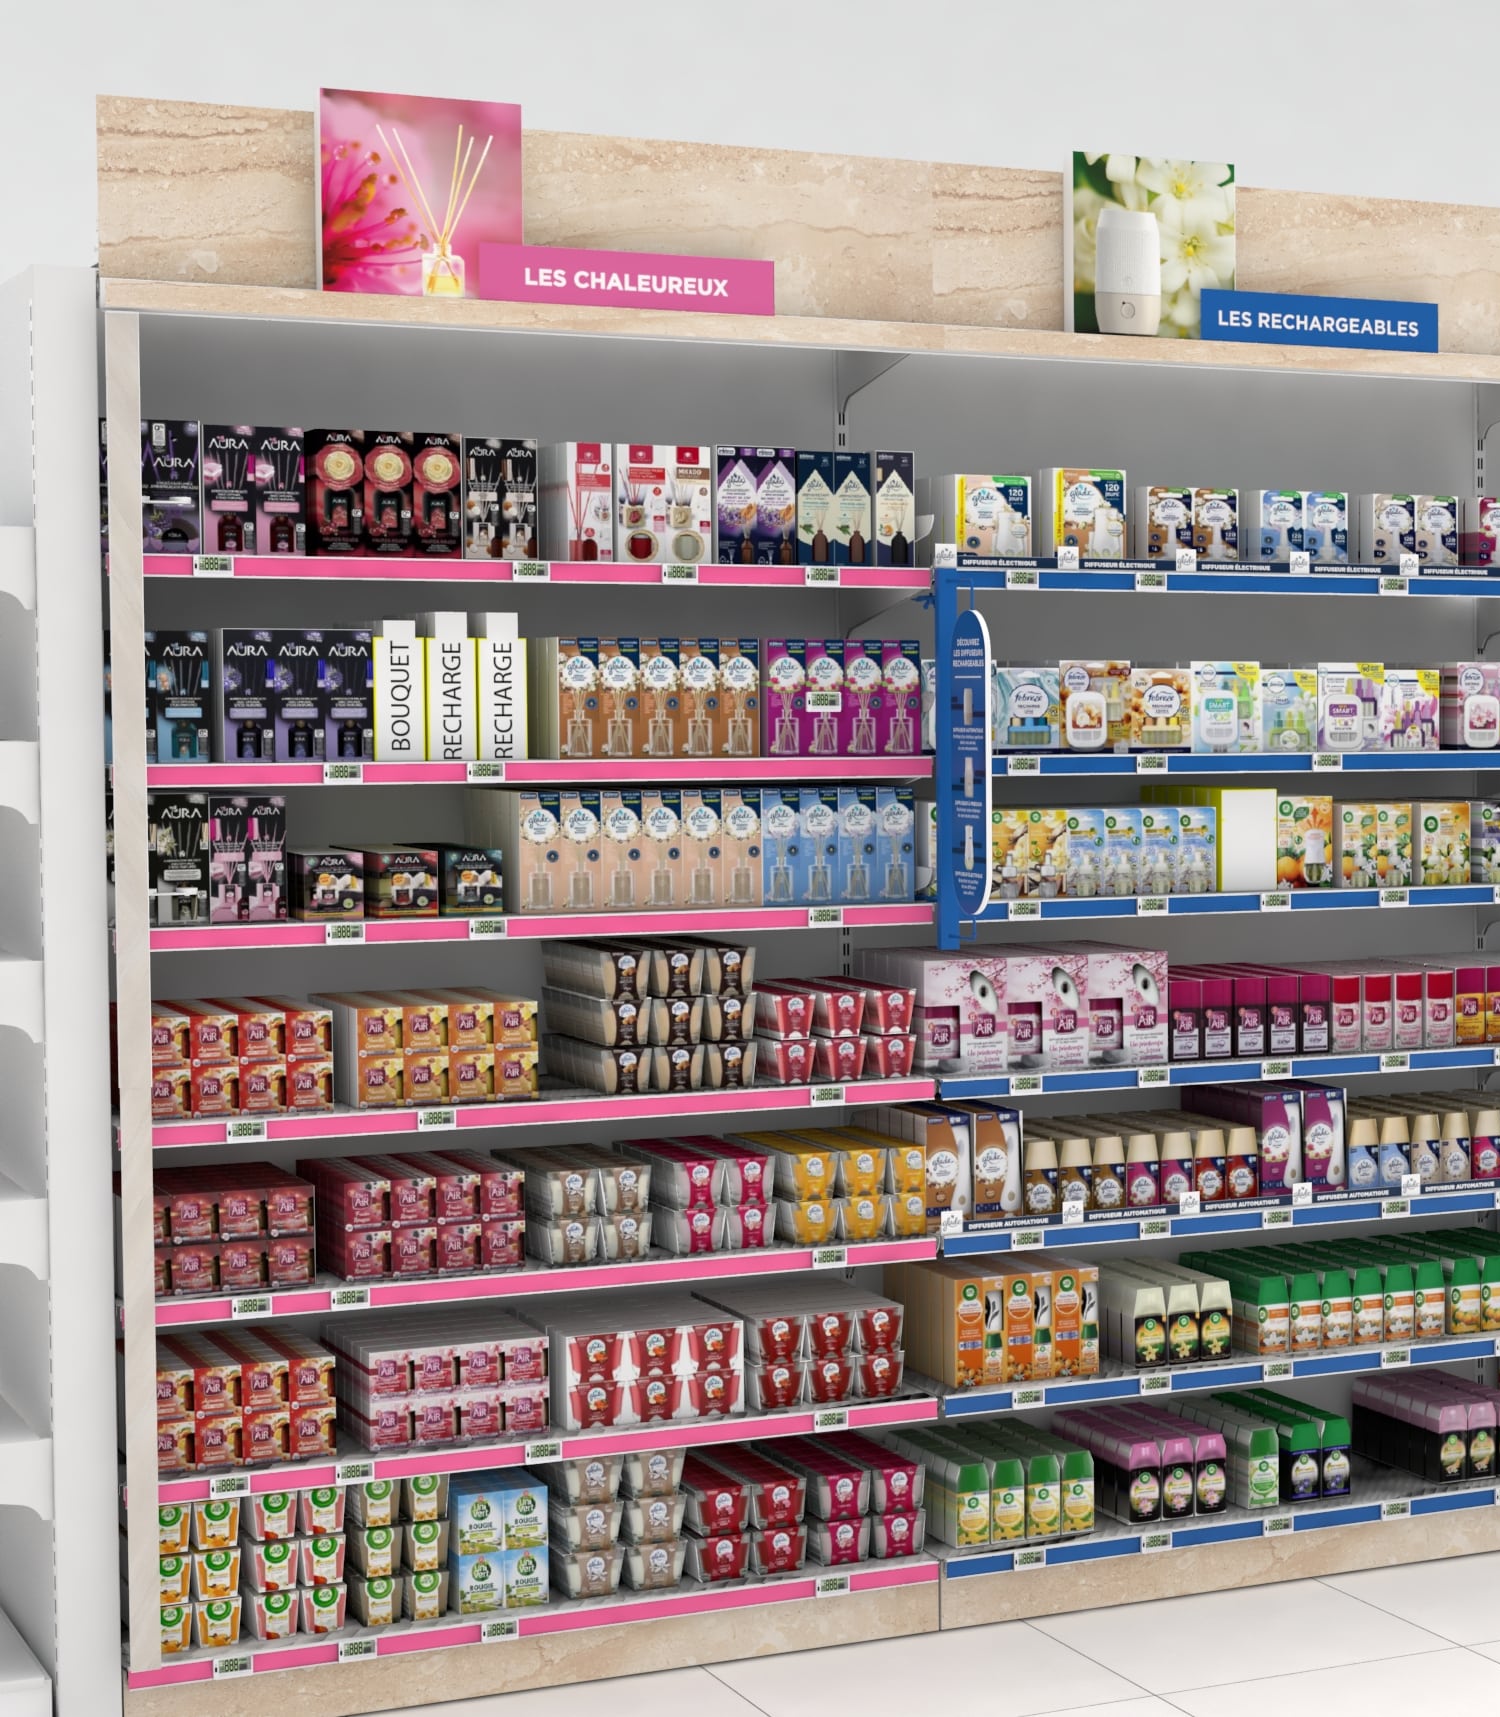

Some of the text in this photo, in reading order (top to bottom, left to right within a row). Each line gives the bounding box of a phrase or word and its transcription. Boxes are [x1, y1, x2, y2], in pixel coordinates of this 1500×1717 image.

[525, 267, 729, 297] LES CHALEUREUX
[1218, 310, 1418, 337] LES RECHARGEABLES
[1105, 484, 1120, 492] 120
[1009, 489, 1023, 497] 120
[963, 558, 1037, 567] DIFFUSEUR ÉLECTRIQUE
[1084, 561, 1156, 569] DIFFUSEUR ÉLECTRIQUE
[1201, 563, 1234, 571] DIFFUSEUR
[1424, 568, 1453, 576] DIFFUSEUR
[390, 640, 411, 751] BOUQUET
[442, 642, 462, 760] RECHARGE
[494, 642, 513, 760] RECHARGE
[1456, 1181, 1495, 1189] AUTOMATIQUE
[1350, 1190, 1389, 1198] AUTOMATIQUE
[1205, 1198, 1280, 1210] DIFFUSEUR AUTOMATIQUE
[1089, 1208, 1166, 1220] DIFFUSEUR AUTOMATIQUE
[969, 1217, 1048, 1230] DIFFUSEUR AUTOMATIQUE
[515, 1516, 538, 1524] BOUGIE
[515, 1577, 539, 1585] BOUGIE
[470, 1583, 493, 1591] BOUGIE
